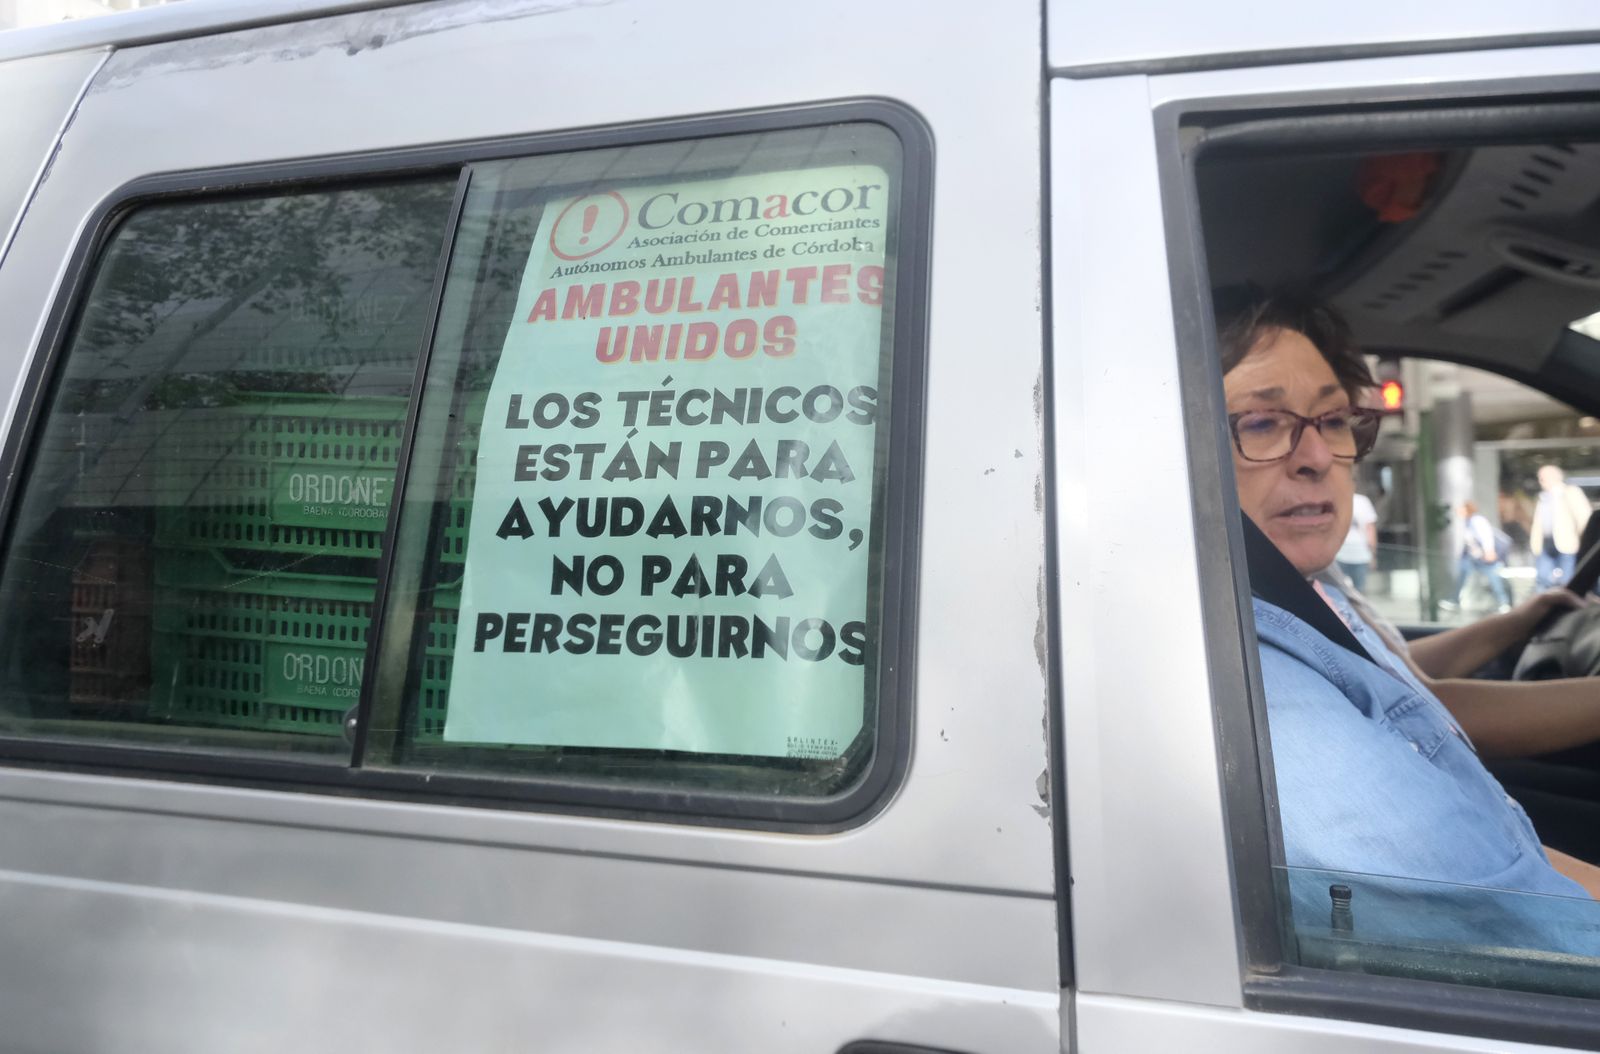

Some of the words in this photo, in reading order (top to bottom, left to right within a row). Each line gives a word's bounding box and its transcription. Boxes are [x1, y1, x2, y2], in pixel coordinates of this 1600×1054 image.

[637, 184, 881, 230] Comacor
[550, 257, 647, 280] Autónomos
[650, 248, 758, 268] Ambulantes
[763, 243, 785, 258] de
[791, 237, 875, 257] Córdoba
[626, 229, 721, 250] Asociación
[727, 226, 749, 241] de
[754, 217, 881, 238] Comerciantes
[526, 263, 885, 323] AMBULANTES
[594, 314, 798, 365] UNIDOS
[505, 392, 602, 430] LOS
[617, 374, 878, 427] TÉCNICOS
[513, 427, 683, 483] ESTÁN
[695, 438, 857, 484] PARA
[495, 493, 864, 551] AYUDARNOS,
[550, 553, 625, 597] NO
[640, 552, 795, 600] PARA
[473, 612, 866, 666] PERSEGUIRNOS
[333, 687, 361, 698] (CORD
